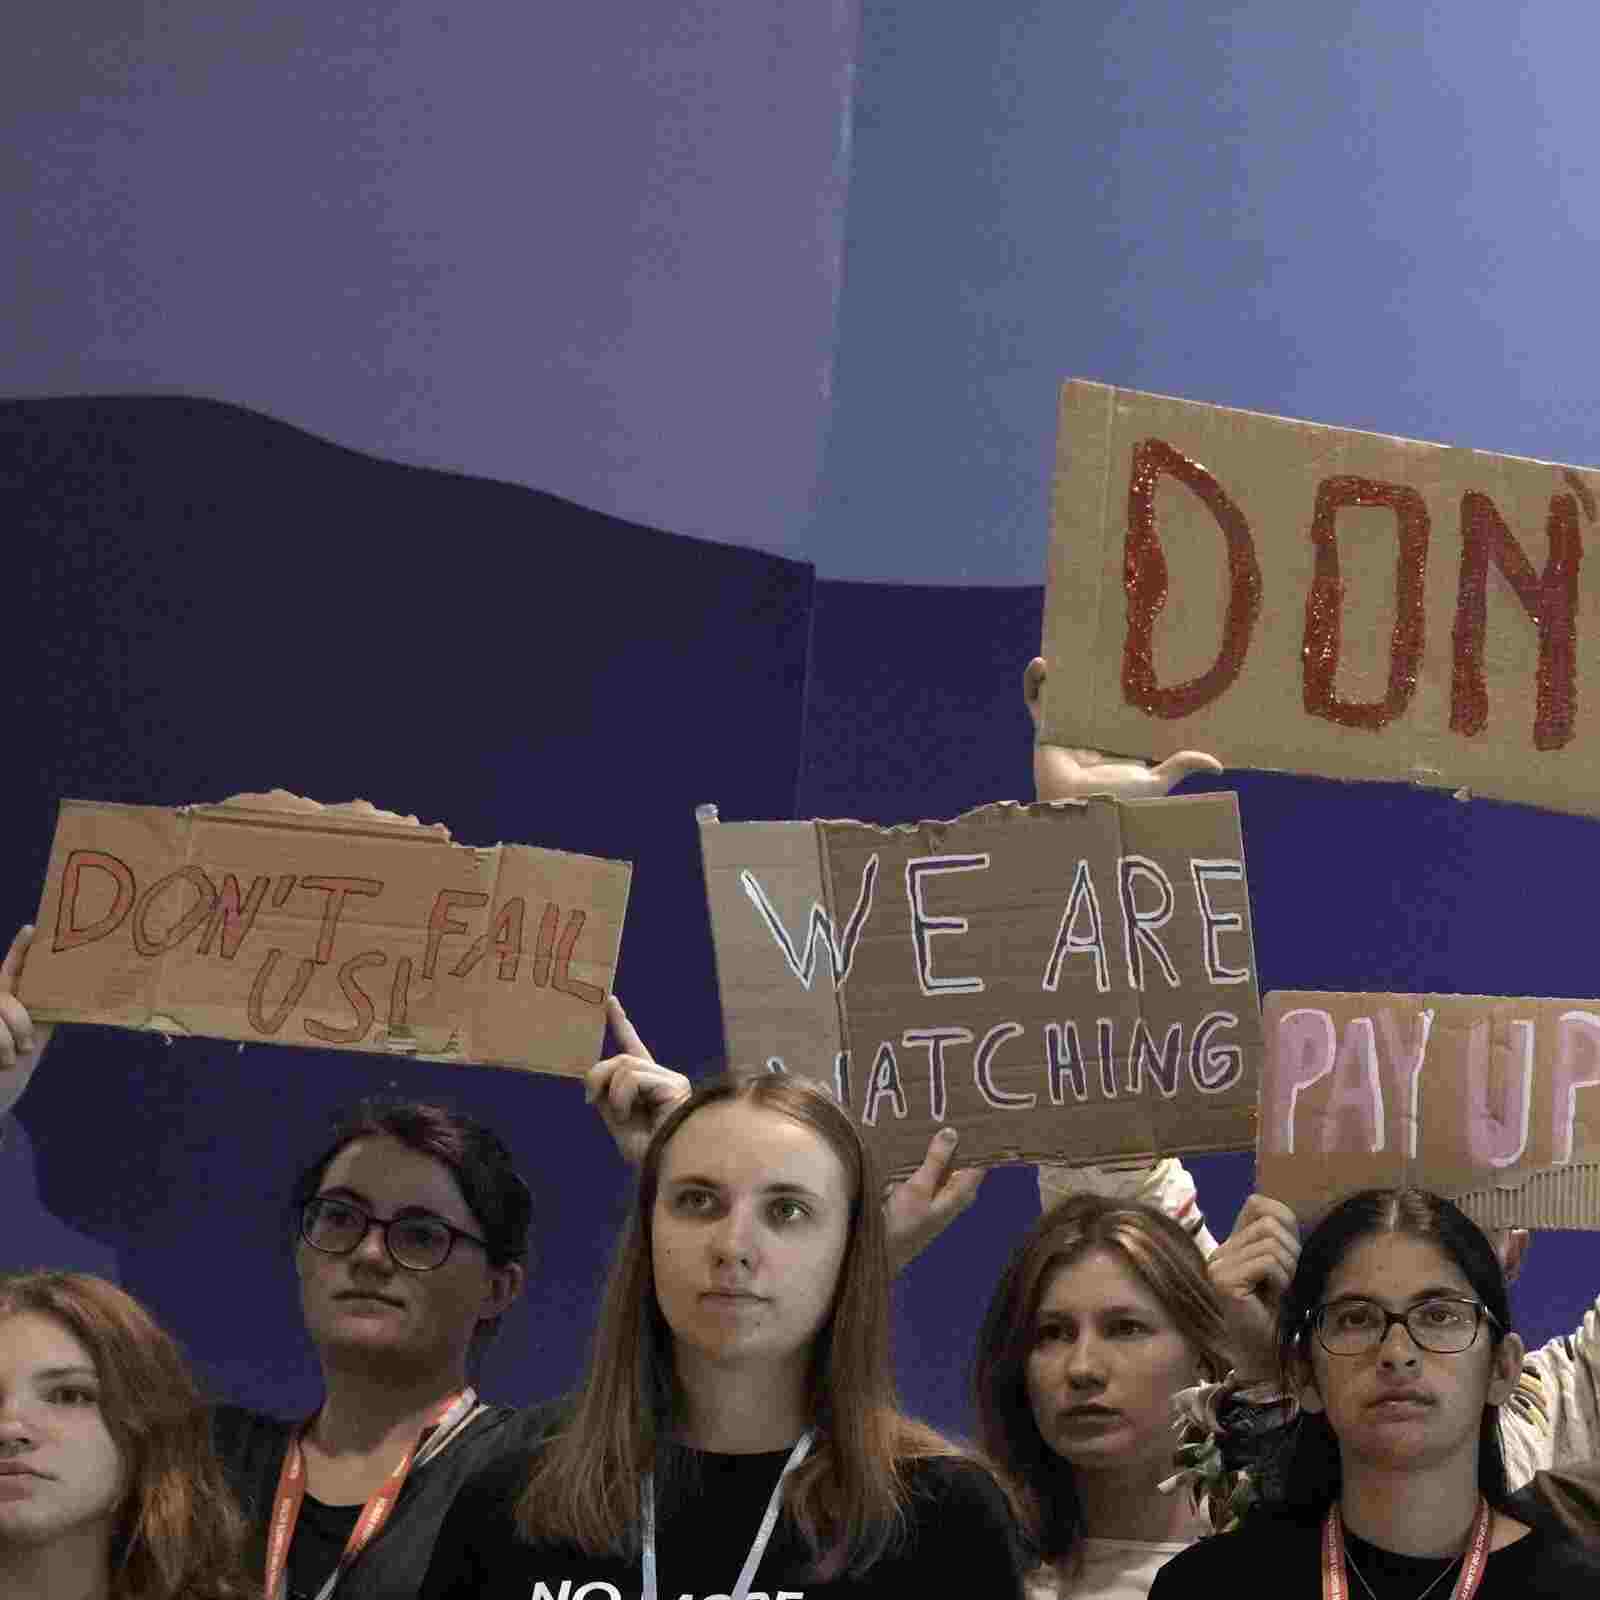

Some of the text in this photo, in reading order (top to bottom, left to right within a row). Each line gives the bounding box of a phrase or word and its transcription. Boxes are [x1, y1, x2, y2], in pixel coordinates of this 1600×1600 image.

[53, 849, 607, 1005] DON'T FAIL
[741, 853, 1250, 996] WE ARE
[1273, 1007, 1435, 1159] PAY
